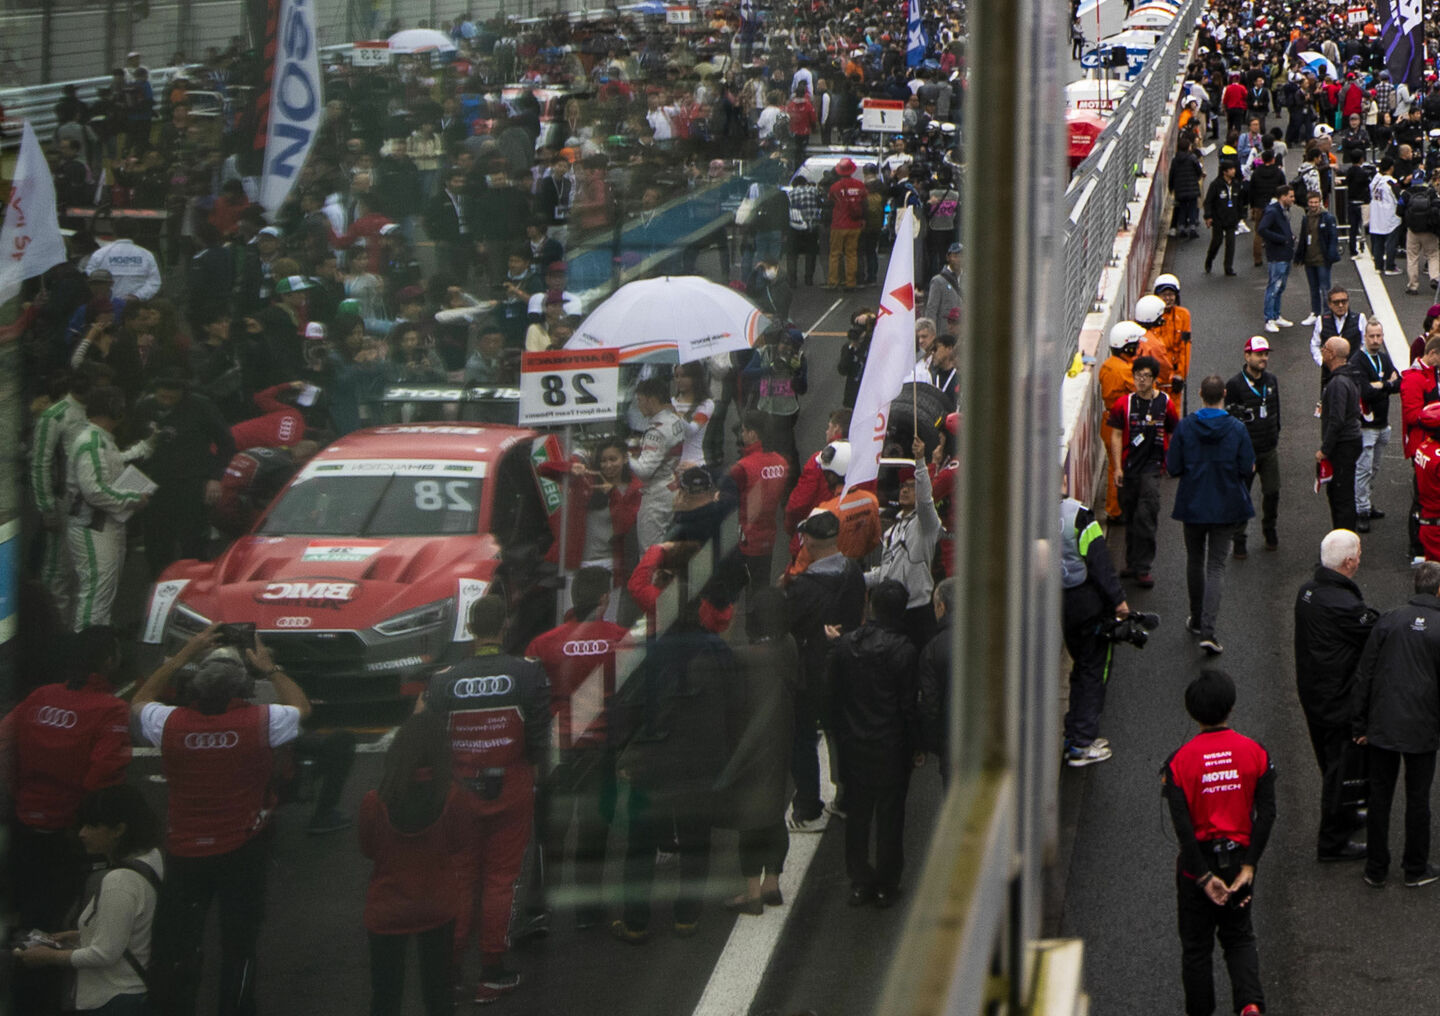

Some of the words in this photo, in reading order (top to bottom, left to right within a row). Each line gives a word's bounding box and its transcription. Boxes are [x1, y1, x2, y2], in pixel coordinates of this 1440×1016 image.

[1203, 751, 1232, 760] NISSAN
[1202, 769, 1239, 783] MOTUL
[1202, 784, 1241, 794] AUTECH
